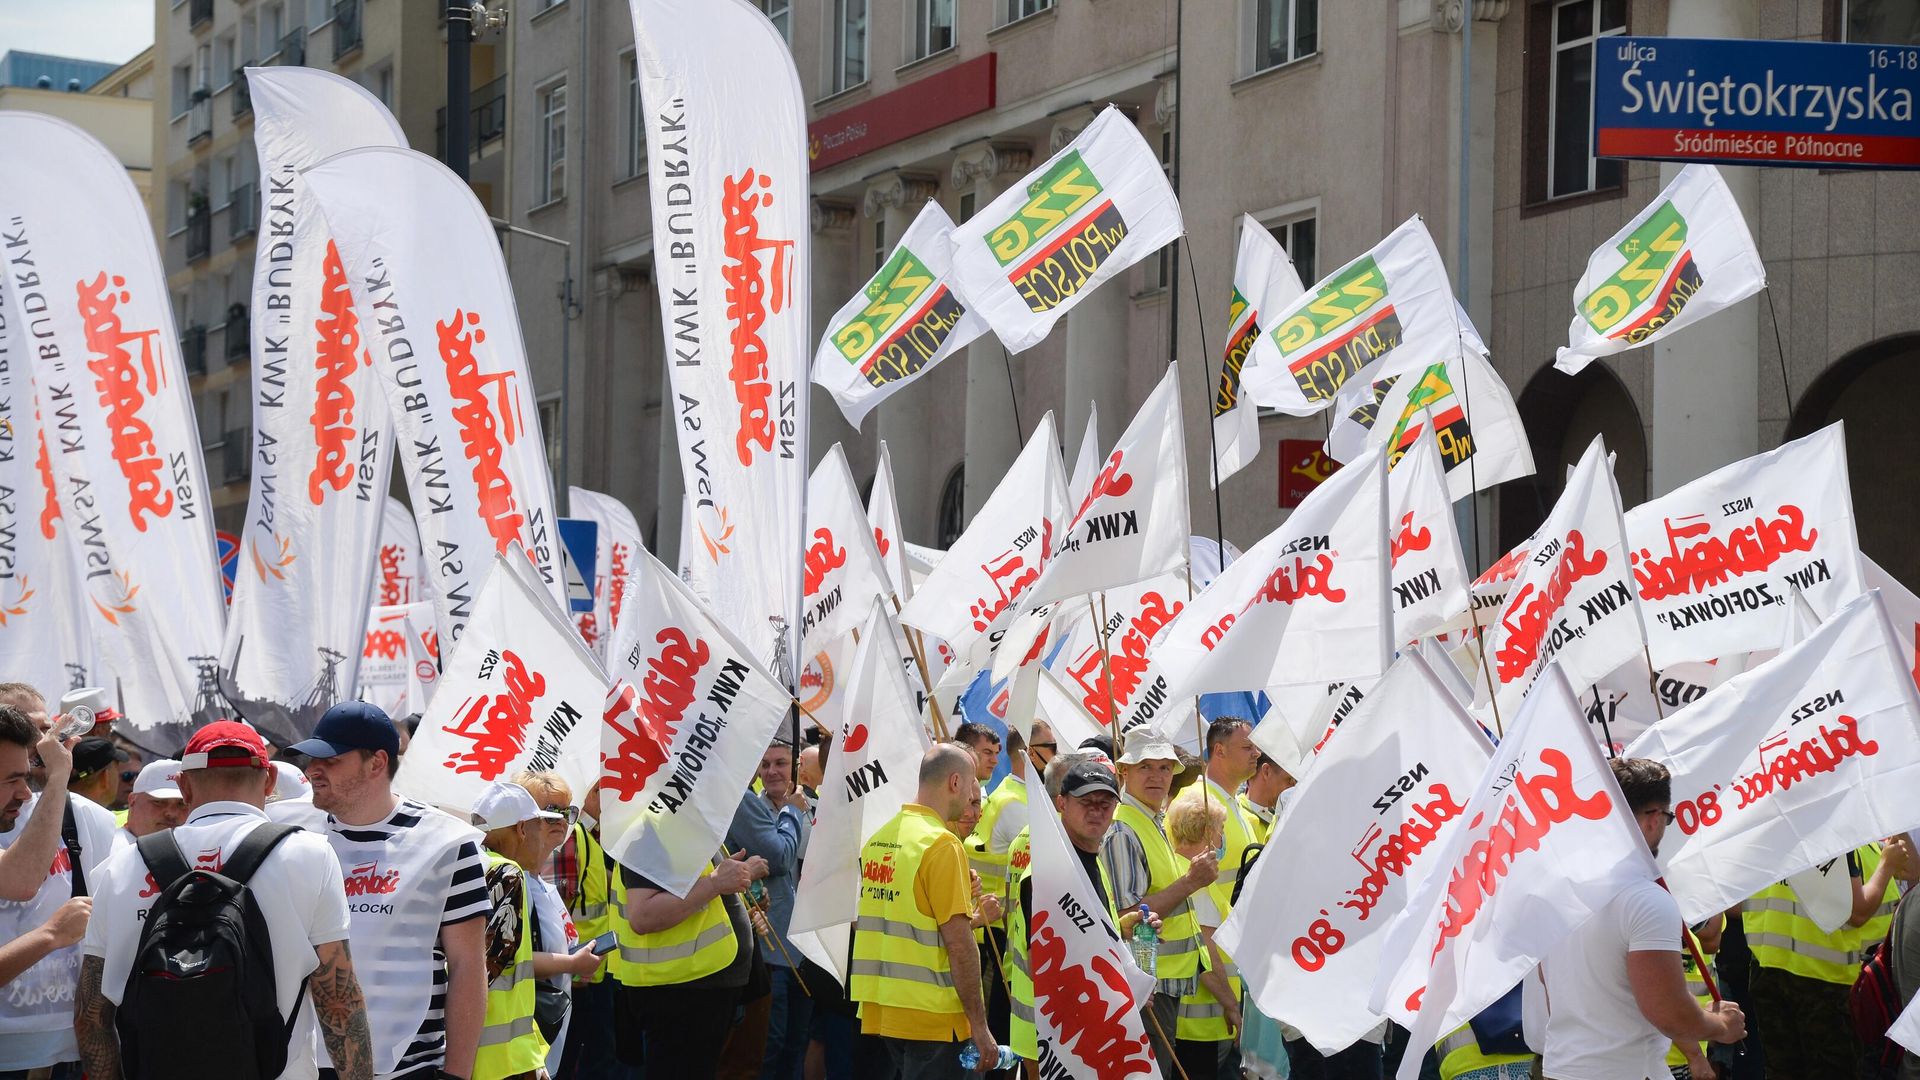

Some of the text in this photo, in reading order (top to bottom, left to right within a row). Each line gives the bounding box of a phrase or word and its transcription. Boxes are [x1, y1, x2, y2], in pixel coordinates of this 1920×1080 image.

[1618, 42, 1657, 62] ulica
[1868, 49, 1918, 70] 16-18
[1621, 60, 1912, 131] Świętokrzyska
[1674, 131, 1863, 158] Śródmieście Północne
[348, 903, 394, 915] ŁOCKI
[1057, 892, 1096, 934] NSZZ
